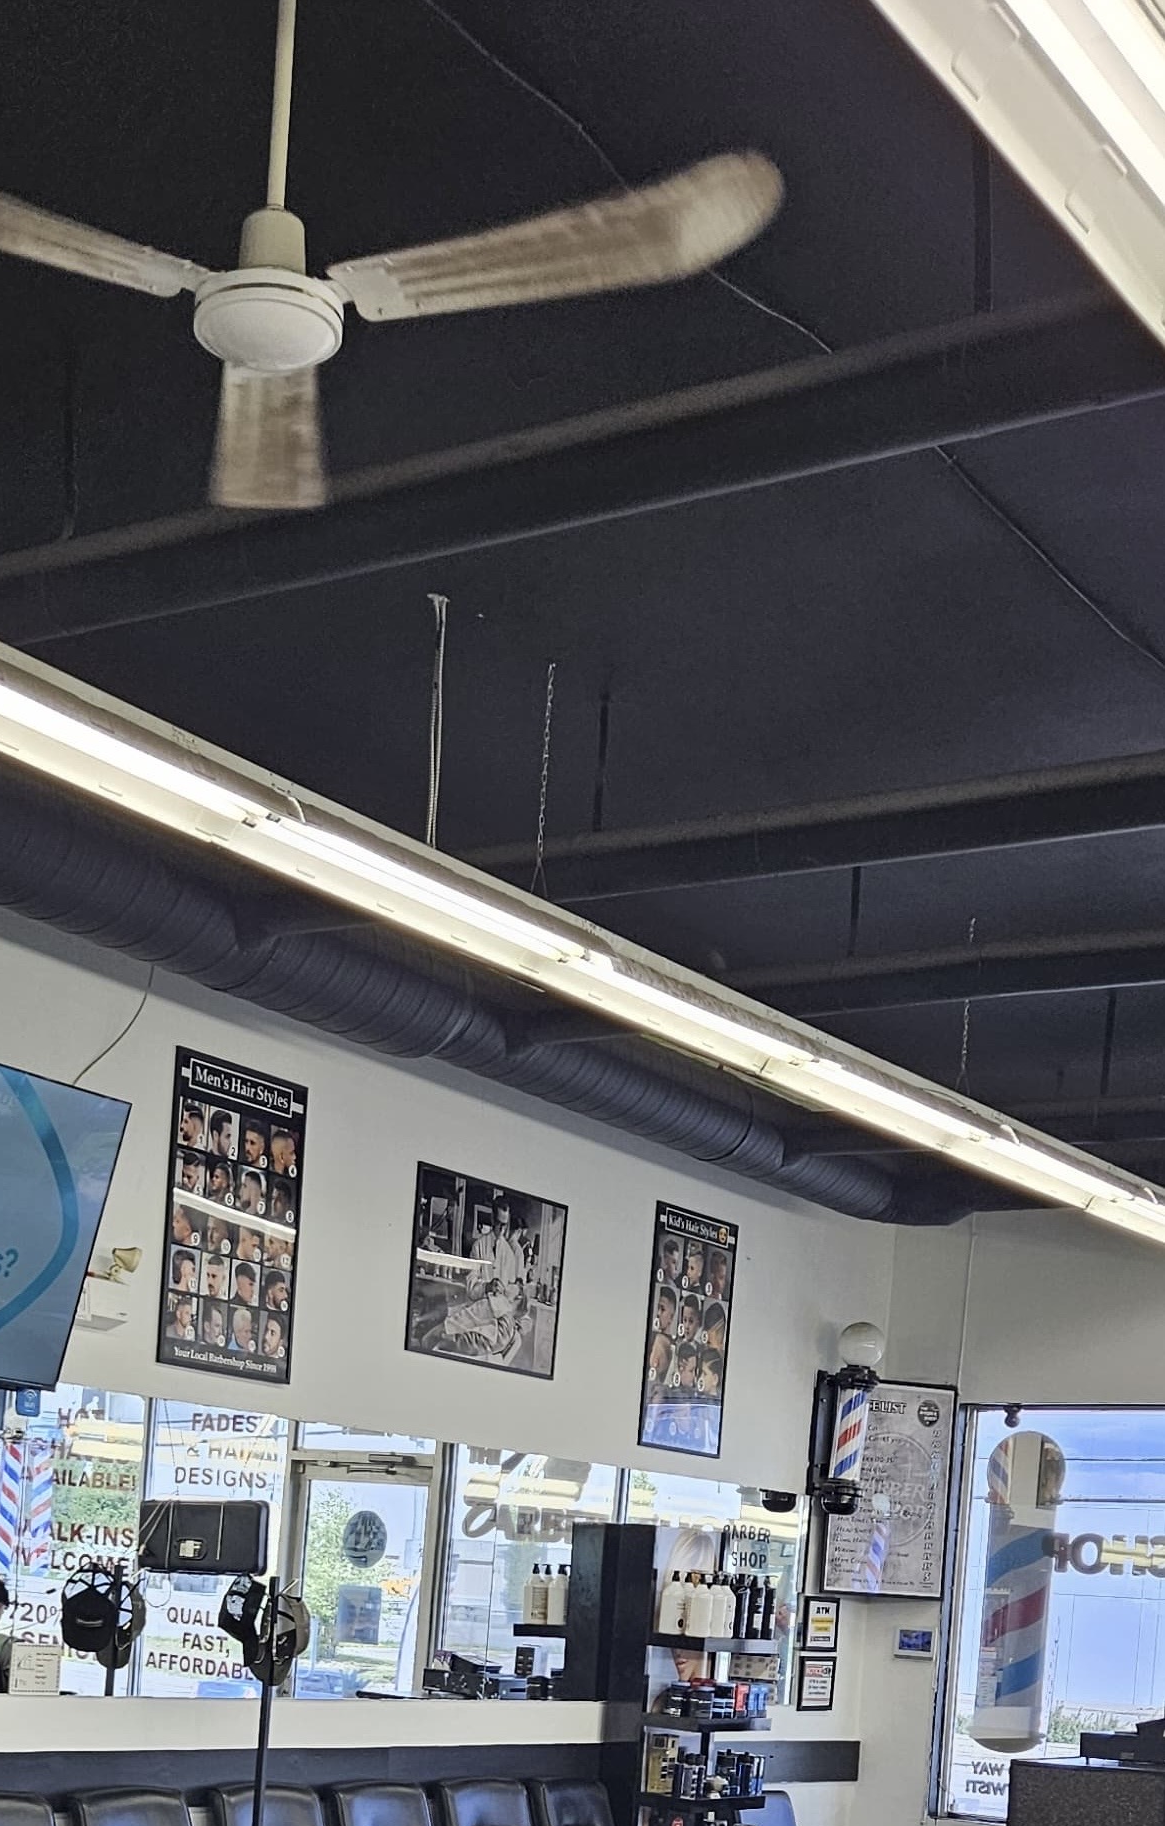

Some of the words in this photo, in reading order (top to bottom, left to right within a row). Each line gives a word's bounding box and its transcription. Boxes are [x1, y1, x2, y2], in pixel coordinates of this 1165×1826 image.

[195, 1066, 229, 1091] Men's
[231, 1077, 255, 1099] Hair
[257, 1085, 289, 1110] Styles
[668, 1213, 685, 1230] Kid's
[191, 1413, 258, 1433] FADES
[175, 1466, 268, 1490] DESIGNS
[731, 1551, 767, 1569] SHOP
[167, 1606, 216, 1628] QUAL
[182, 1632, 231, 1658] FAST,
[145, 1651, 255, 1682] AFFORDABL
